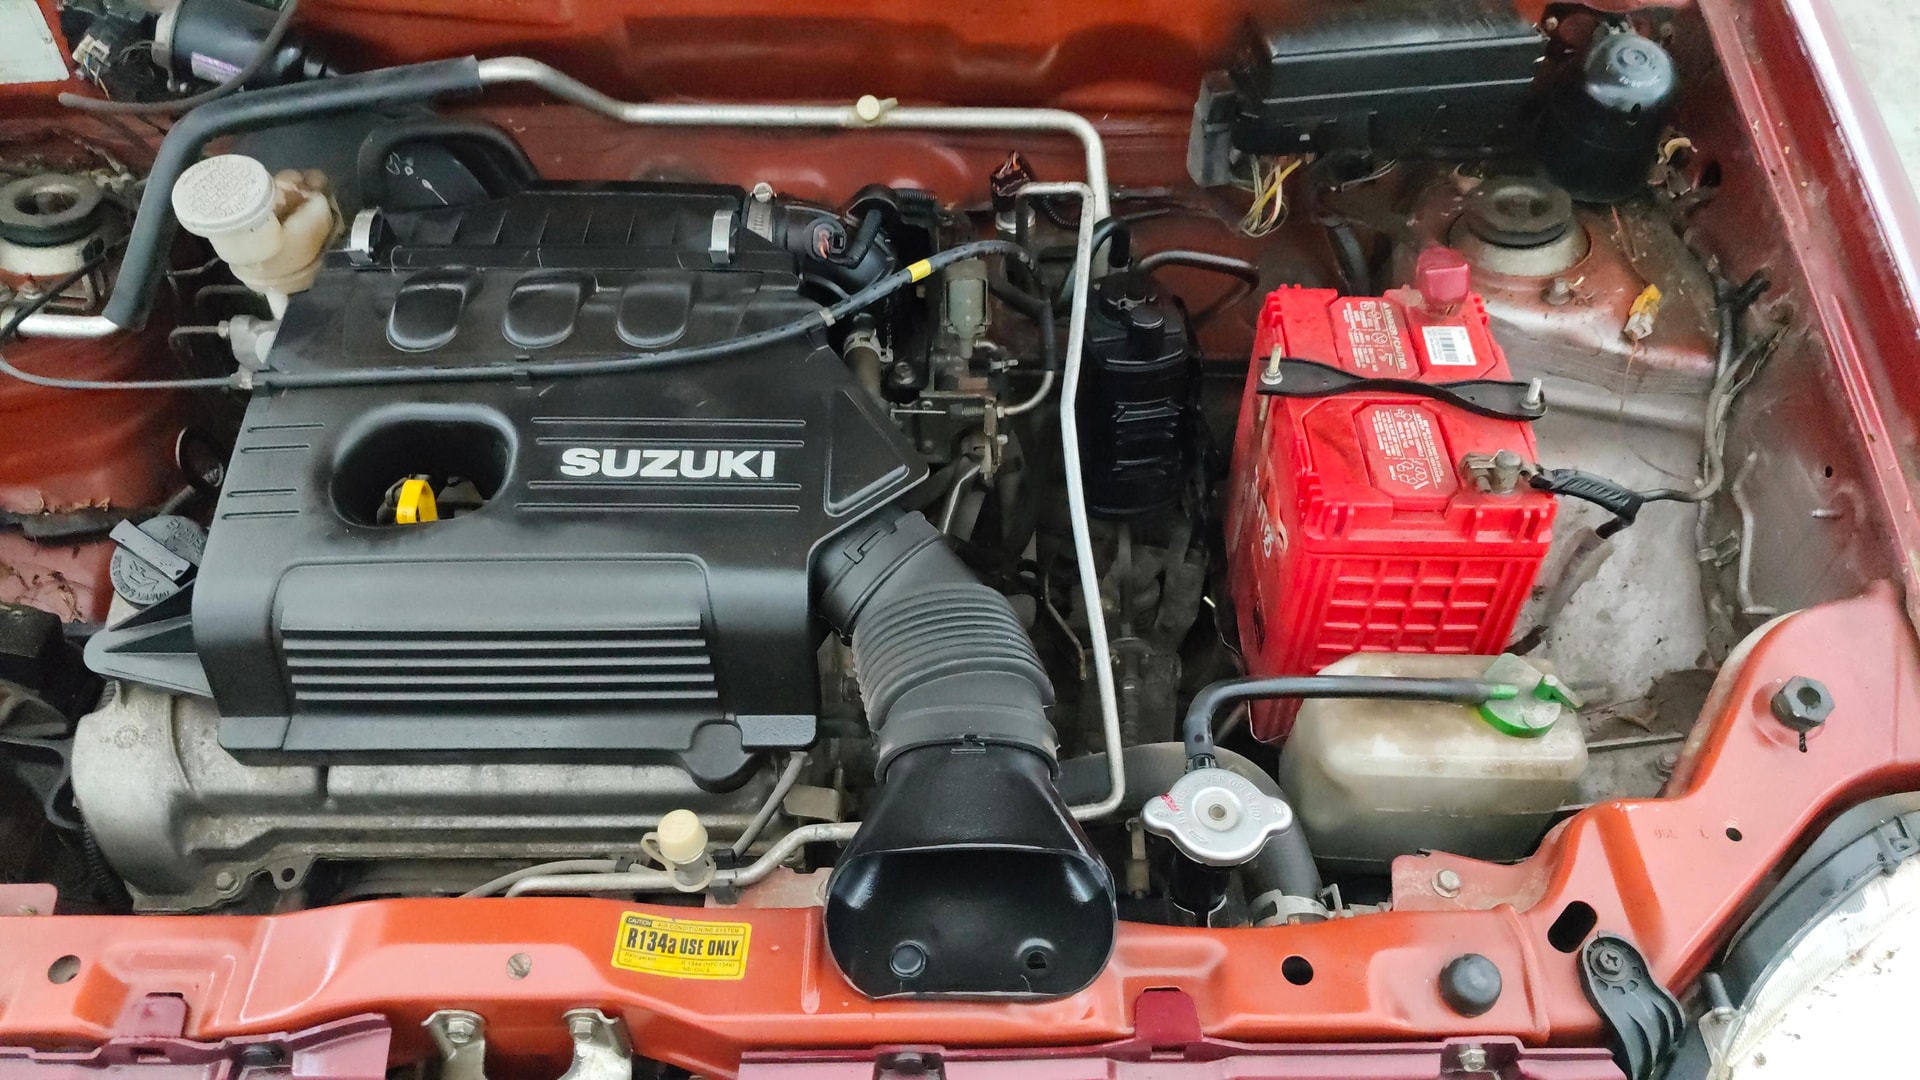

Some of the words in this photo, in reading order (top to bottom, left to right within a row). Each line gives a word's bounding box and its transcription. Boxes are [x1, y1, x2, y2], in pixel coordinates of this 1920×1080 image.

[560, 447, 776, 478] SUZUKI
[627, 917, 652, 927] CAUTION
[657, 922, 669, 930] AIR
[669, 923, 714, 933] CONDITIONING
[626, 927, 677, 955] R134a
[679, 937, 705, 956] USE
[707, 939, 739, 957] ONLY
